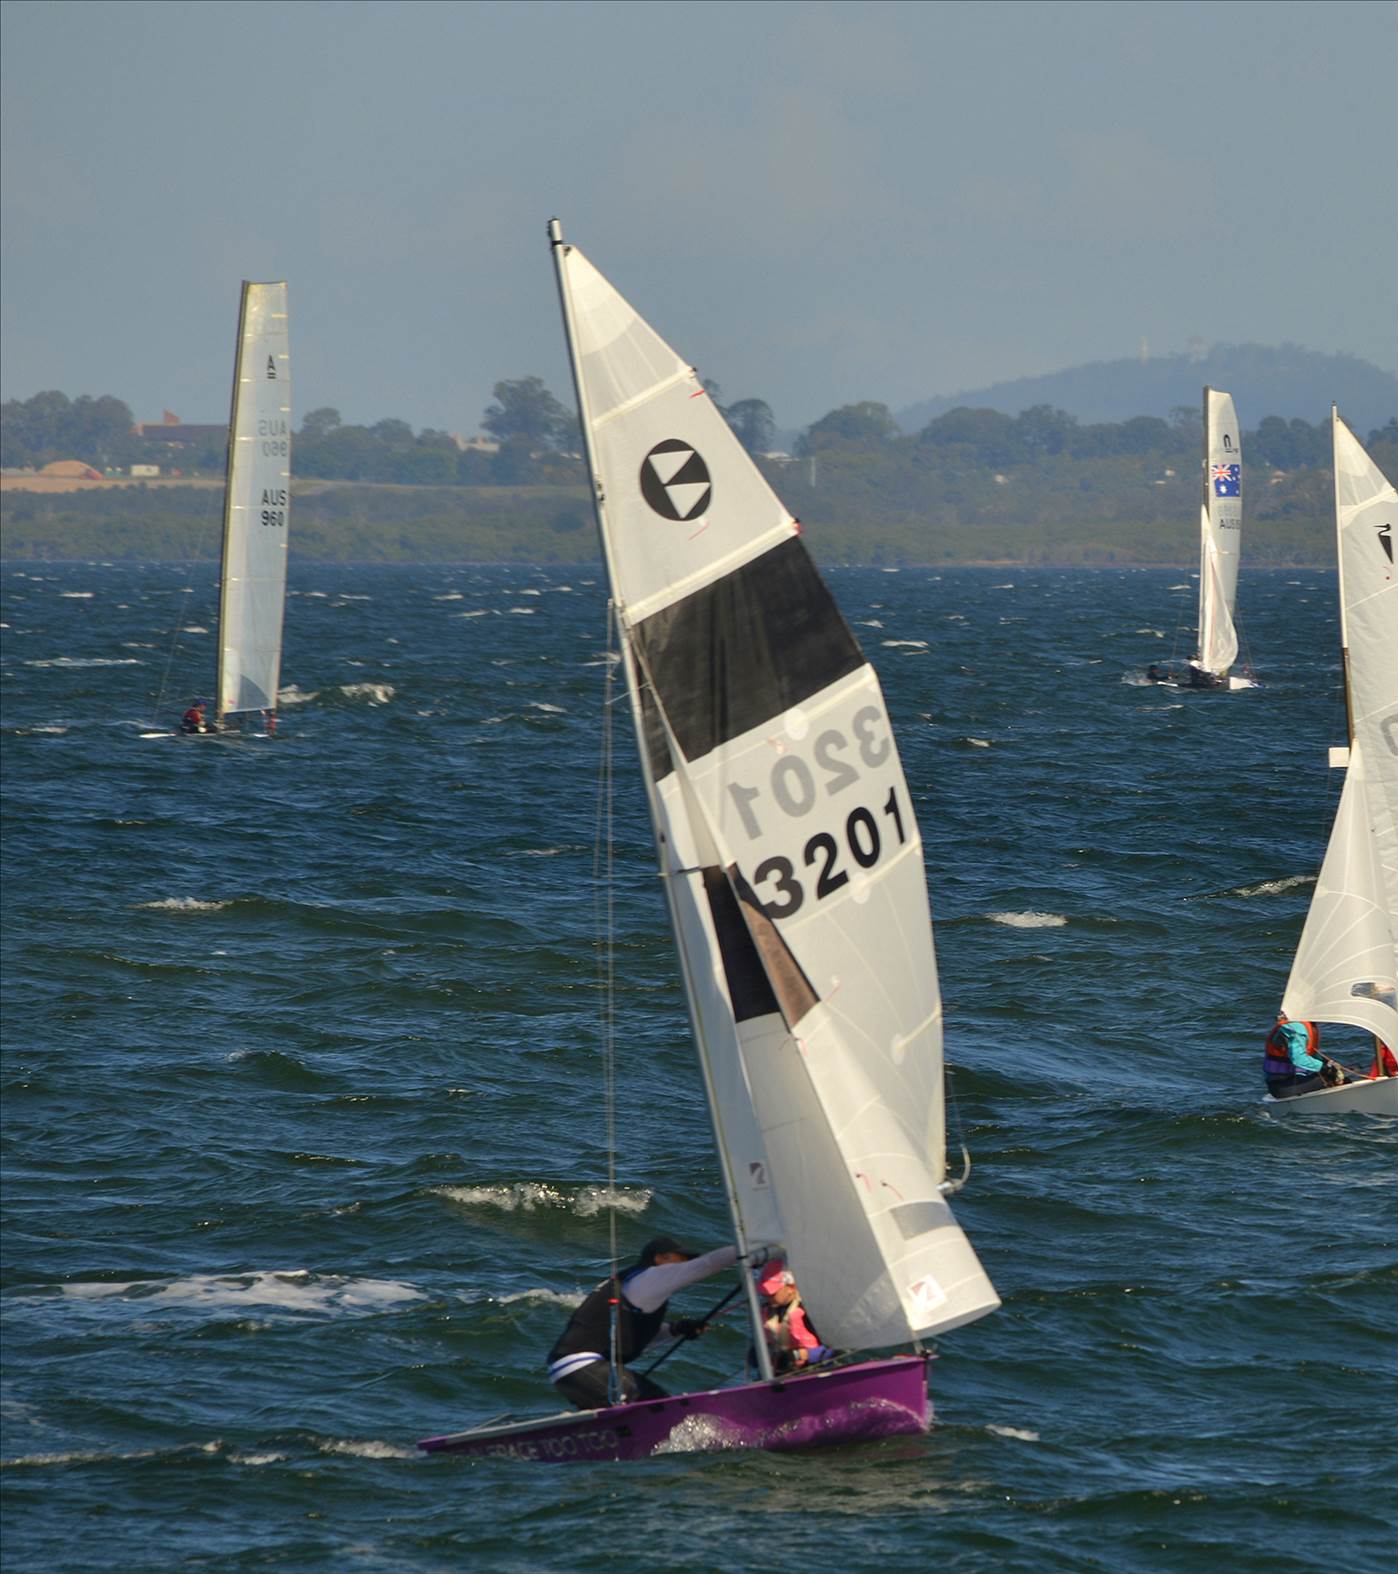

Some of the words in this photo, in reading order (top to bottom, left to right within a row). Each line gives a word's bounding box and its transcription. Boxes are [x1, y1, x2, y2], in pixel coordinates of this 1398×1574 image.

[261, 489, 287, 507] AUS
[261, 510, 285, 527] 960
[753, 786, 906, 919] 3201
